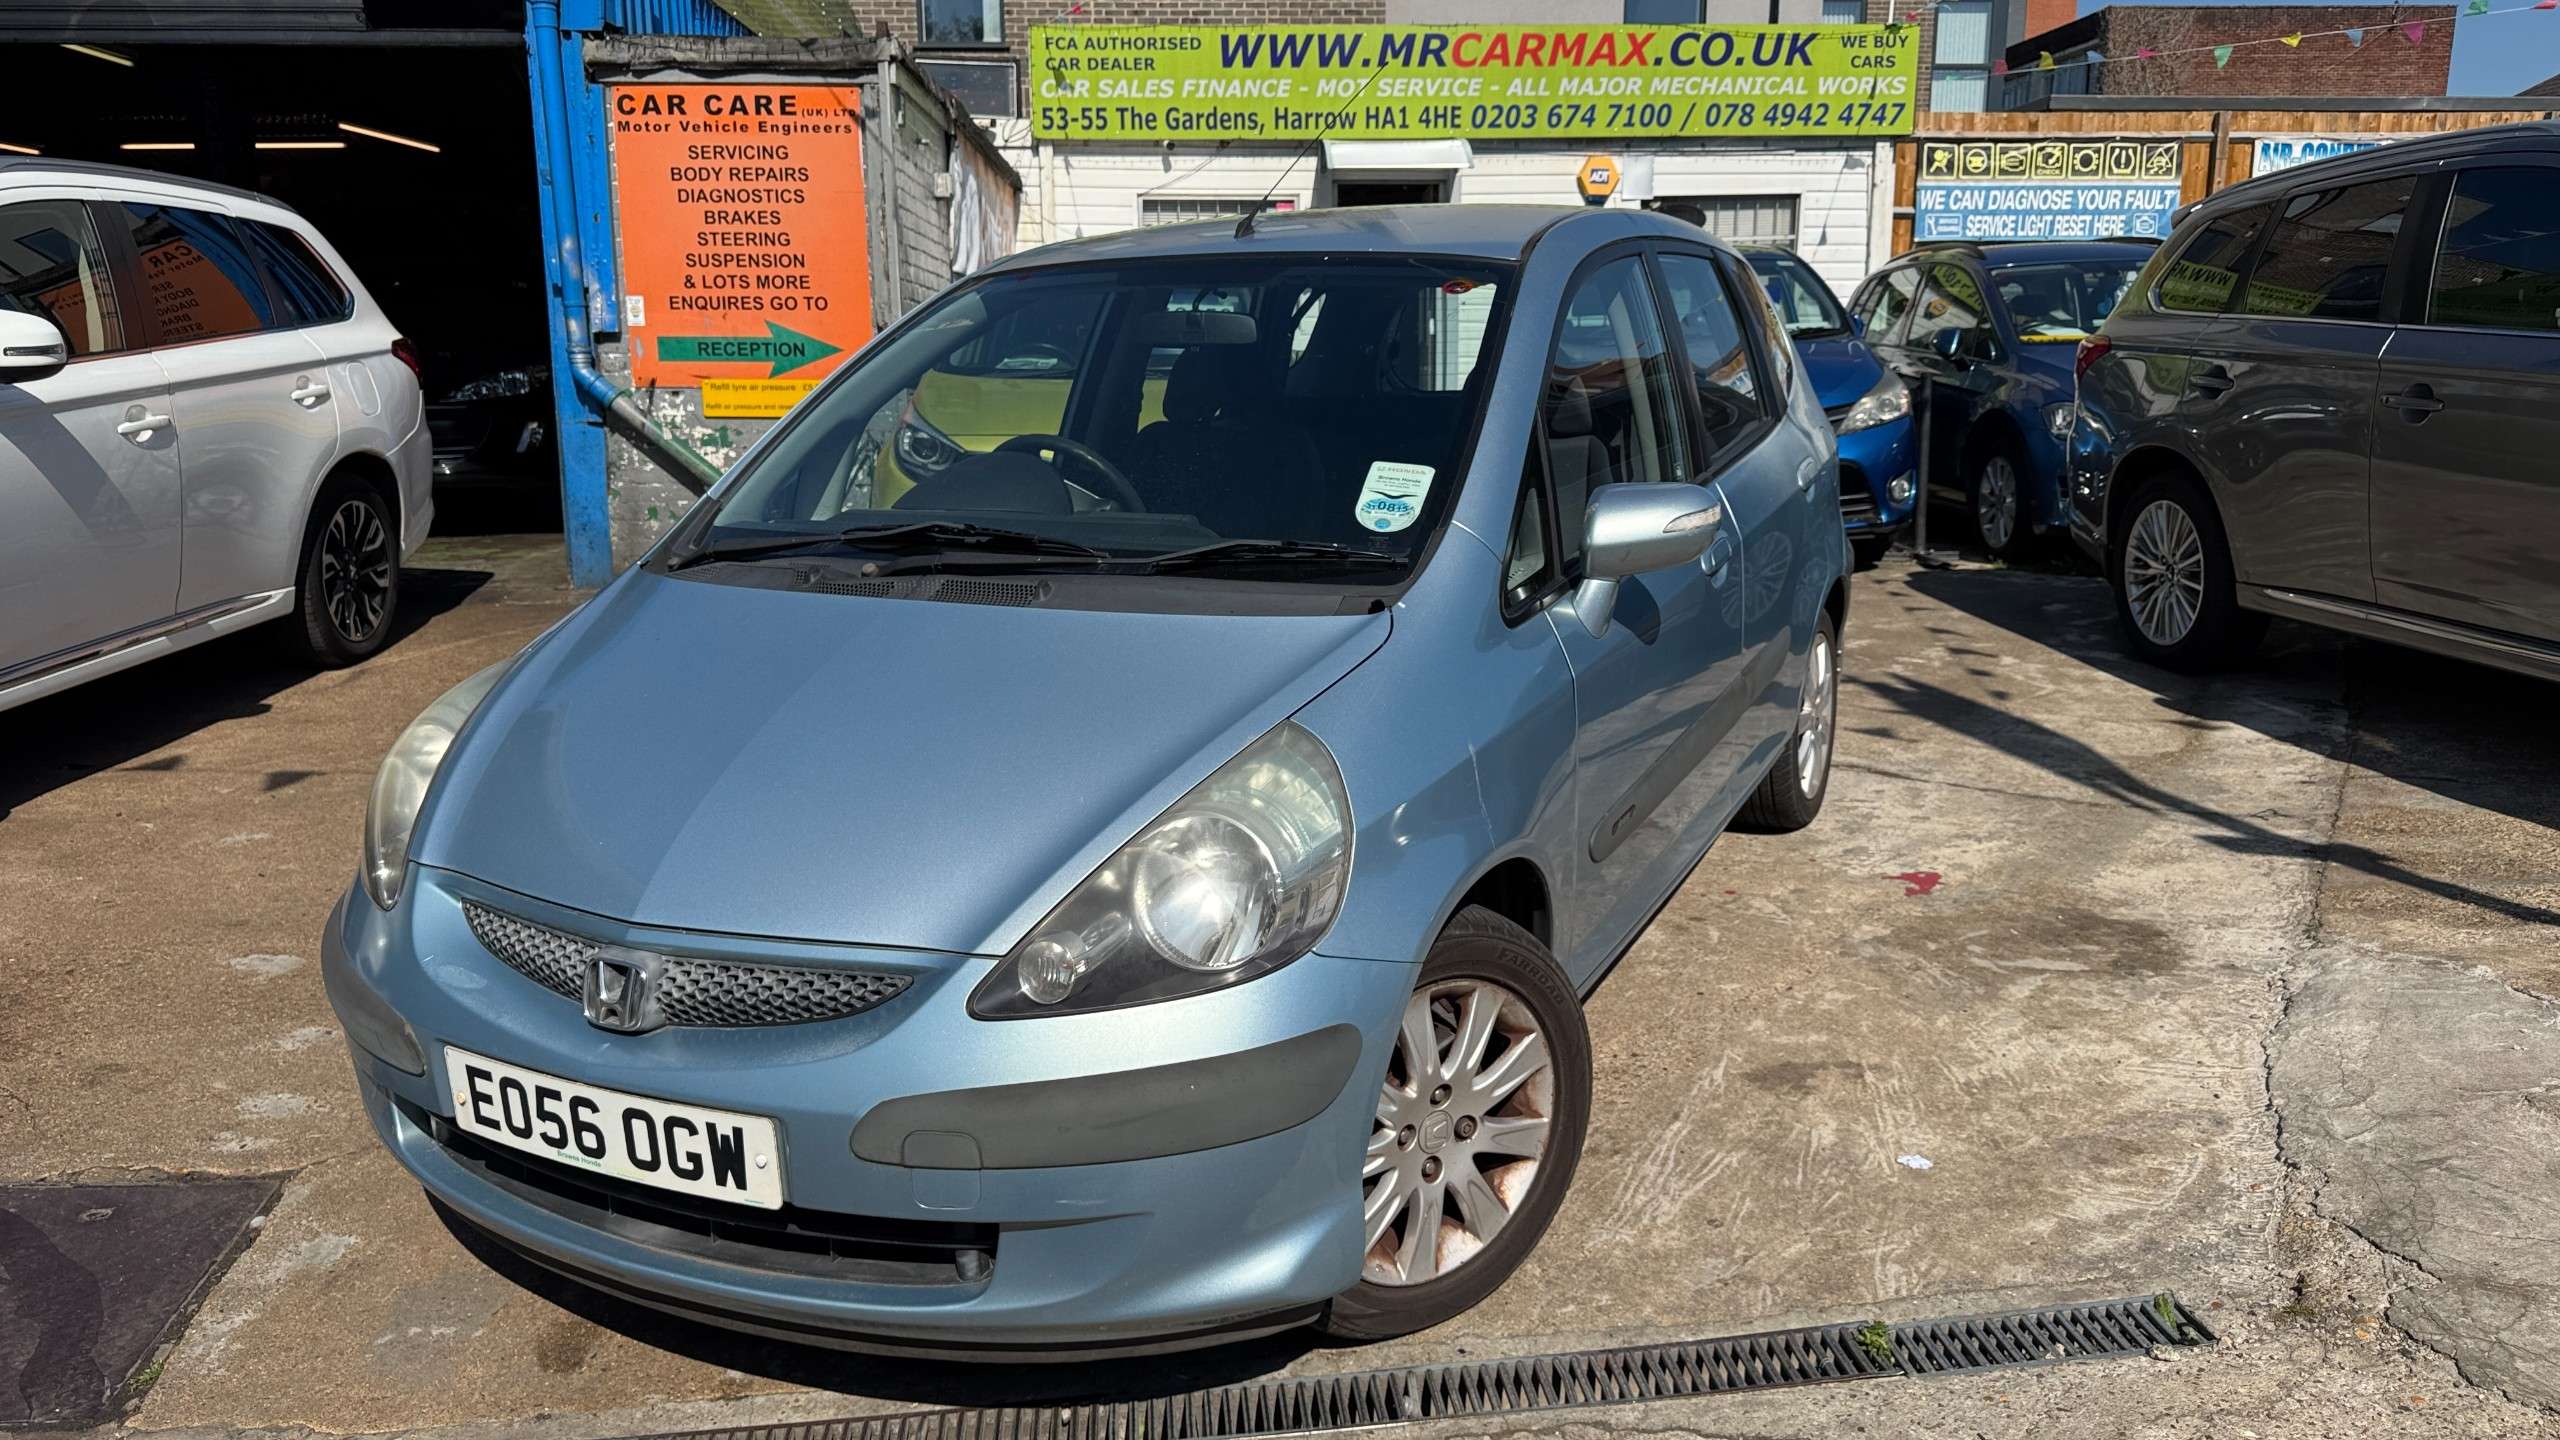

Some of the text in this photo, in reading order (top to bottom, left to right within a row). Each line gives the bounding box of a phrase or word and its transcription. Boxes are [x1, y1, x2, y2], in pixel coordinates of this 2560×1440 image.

[1045, 36, 1201, 51] FCA AUTHORISED
[1220, 31, 1819, 69] WWW.MRCARMAX.CO.UK
[1841, 35, 1909, 49] WE BUY
[1045, 56, 1155, 72] CAR DEALER
[1850, 54, 1896, 69] CARS
[1040, 79, 1090, 99] CAR
[1097, 78, 1175, 98] SALES
[1182, 77, 1291, 98] FINANCE
[1316, 77, 1370, 97] MOT
[1376, 77, 1483, 97] SERVICE
[1506, 77, 1551, 97] ALL
[1558, 77, 1642, 97] MAJOR
[1649, 76, 1808, 96] MECHANICAL
[1815, 76, 1907, 95] WORKS
[617, 94, 857, 119] CAR CARE (UK) LTD
[1041, 107, 1109, 131] 53-55
[1116, 107, 1157, 131] The
[1165, 106, 1265, 134] Gardens,
[1274, 106, 1356, 130] Harrow
[1365, 106, 1409, 129] HA1
[1418, 105, 1461, 129] 4HE
[1470, 104, 1537, 129] 0203
[1547, 104, 1596, 128] 674
[1606, 103, 1672, 128] 7100
[1705, 103, 1758, 127] 078
[1764, 103, 1828, 127] 4942
[1838, 102, 1906, 126] 4747
[617, 121, 853, 136] Motor Vehicle Engineers
[688, 145, 789, 161] SERVICING
[670, 167, 809, 183] BODY REPAIRS
[677, 189, 805, 205] DIAGNOSTICS
[1920, 189, 2173, 210] WE CAN DIAGNOSE YOUR FAULT
[704, 210, 781, 226] BRAKES
[1966, 215, 2017, 236] SERVICE
[2017, 215, 2051, 236] LIGHT
[2053, 215, 2093, 236] RESET
[2093, 214, 2126, 236] HERE
[697, 232, 791, 247] STEERING
[685, 253, 805, 269] SUSPENSION
[684, 275, 811, 290] & LOTS MORE
[669, 296, 829, 312] ENQUIRES GO TO
[698, 341, 806, 358] RECEPTION
[710, 383, 730, 391] Refill
[732, 384, 747, 392] tyre
[749, 383, 759, 391] air
[761, 384, 796, 393] pressure
[621, 1107, 748, 1192] OGW
